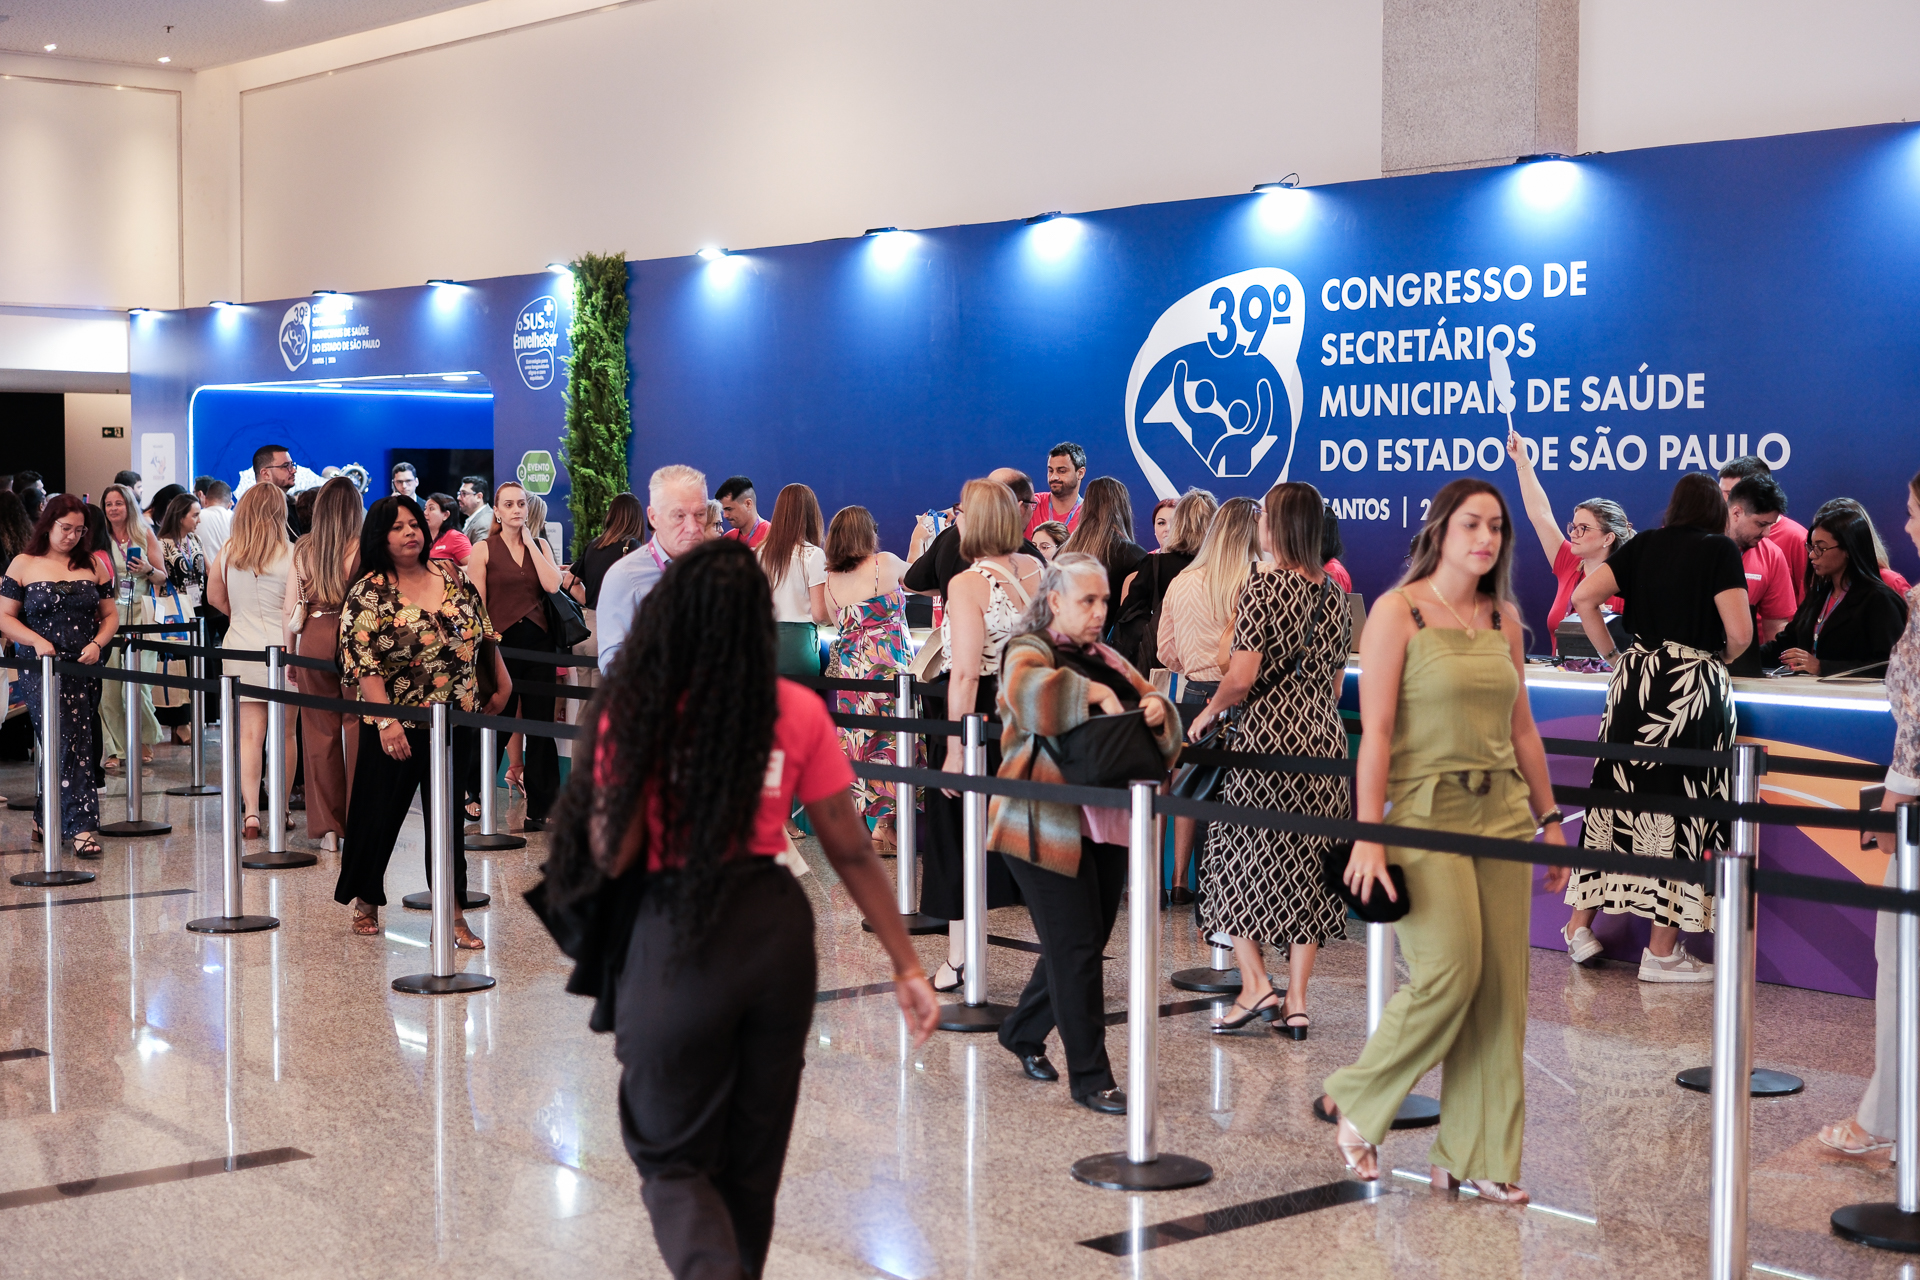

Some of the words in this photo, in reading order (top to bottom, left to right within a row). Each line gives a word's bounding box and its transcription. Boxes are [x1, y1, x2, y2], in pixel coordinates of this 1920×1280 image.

[1321, 264, 1533, 311] CONGRESSO
[1543, 261, 1587, 298] DE
[523, 312, 545, 330] SUS
[1206, 284, 1291, 357] 39º
[312, 343, 320, 353] DO
[362, 339, 380, 350] PAULO
[513, 331, 558, 349] EnvelheSer
[1321, 315, 1537, 366] SECRETÁRIOS
[1527, 378, 1570, 412] DE
[1580, 362, 1705, 412] SAÚDE
[1320, 438, 1368, 472] DO
[1377, 436, 1505, 472] ESTADO
[1569, 425, 1647, 472] SÃO
[527, 463, 549, 471] EVENTO
[527, 474, 550, 482] NEUTRO
